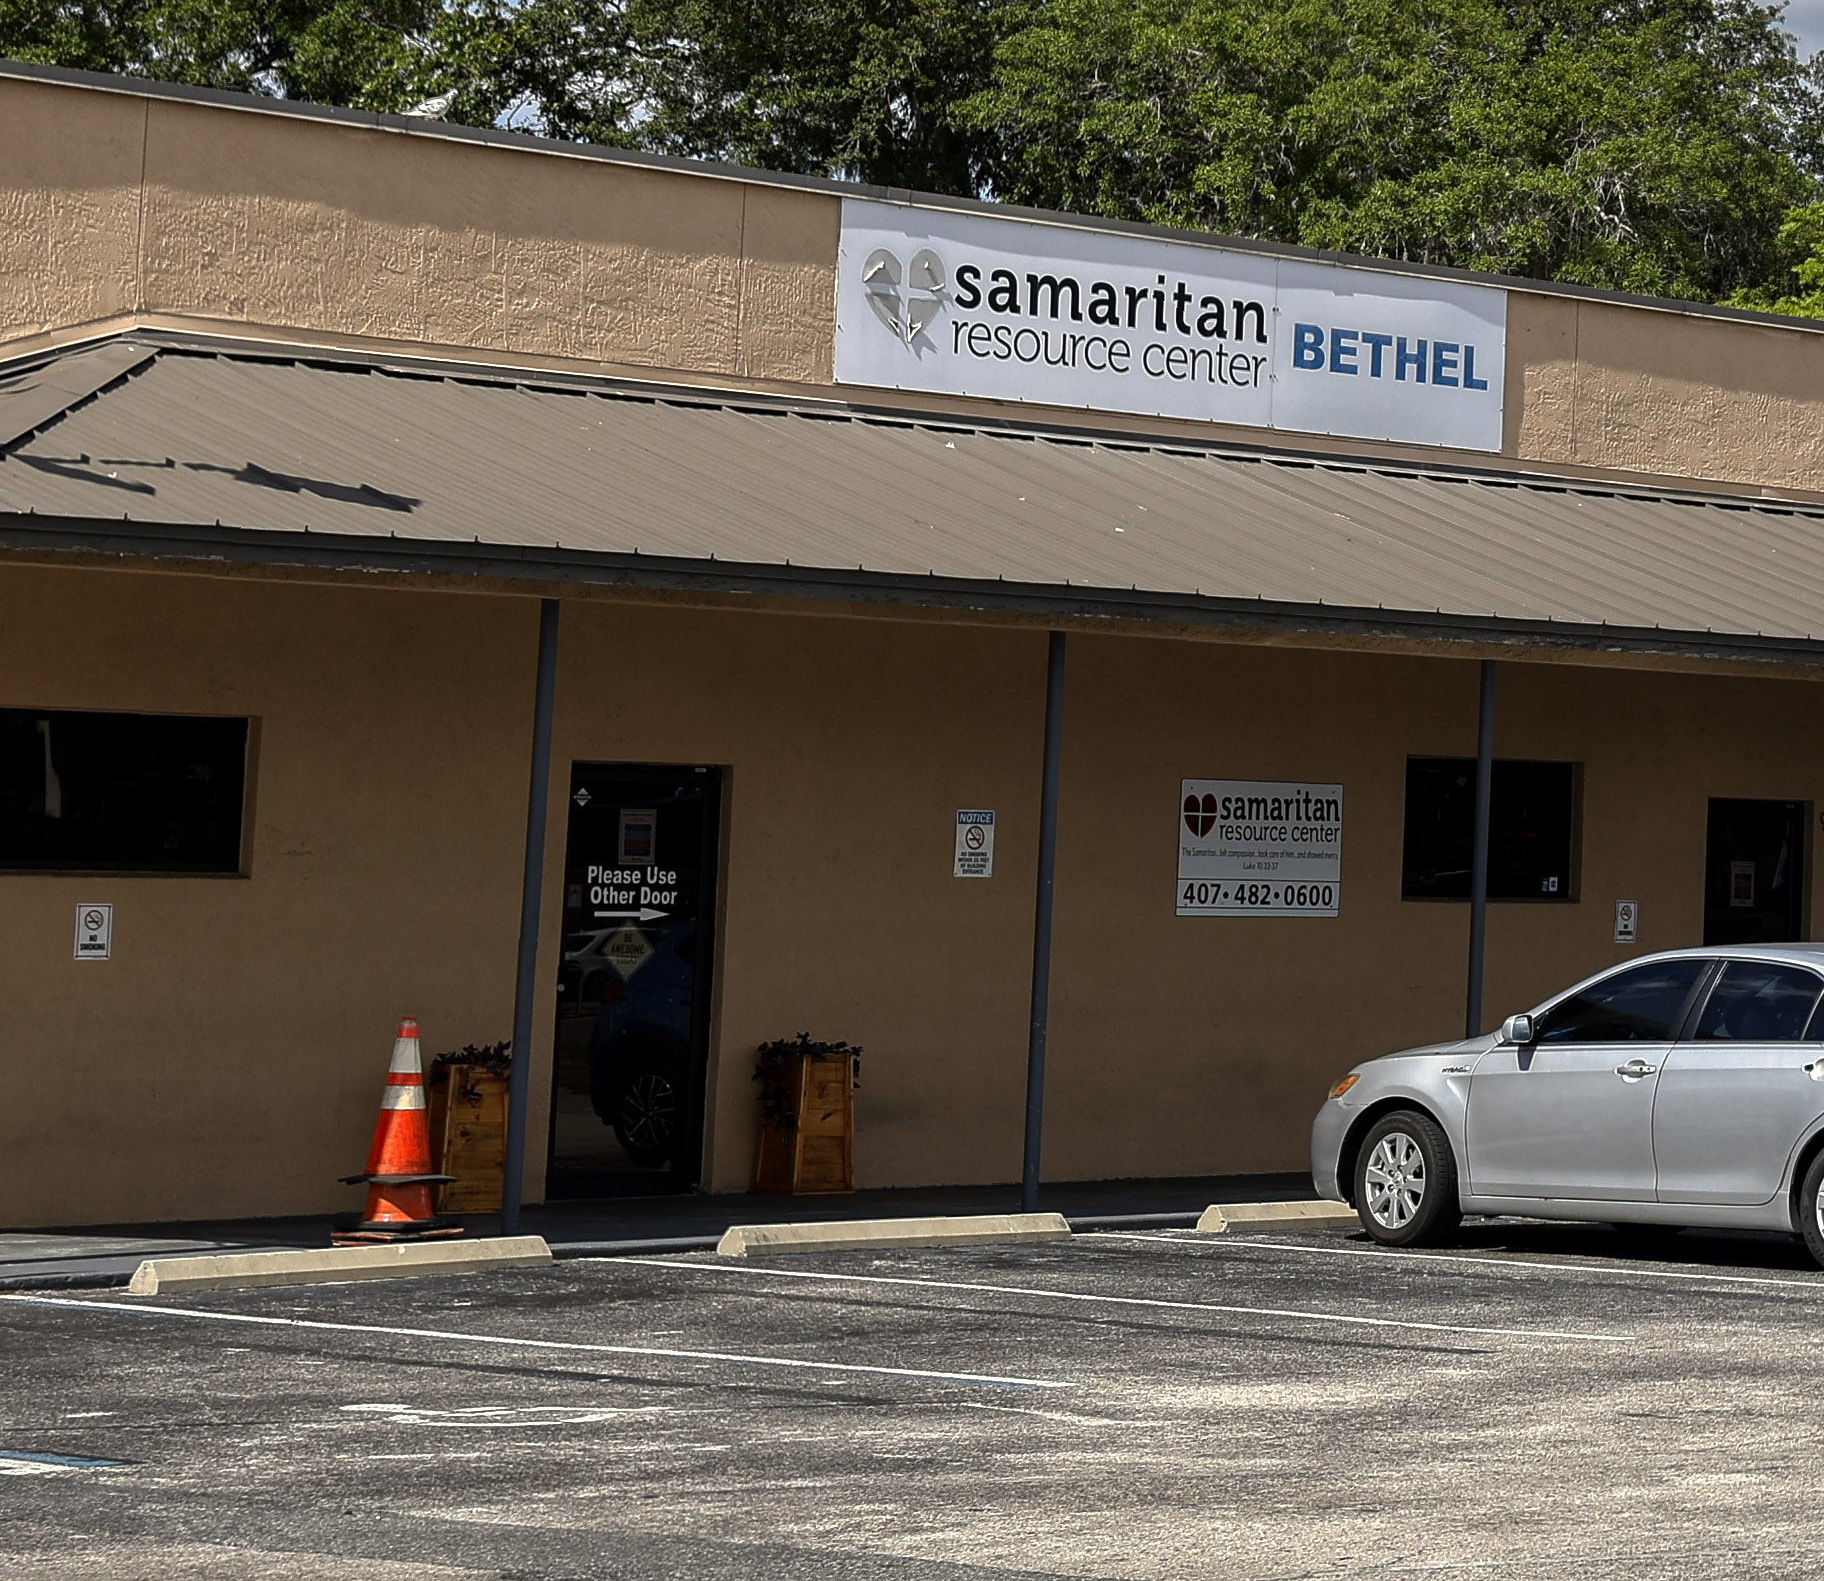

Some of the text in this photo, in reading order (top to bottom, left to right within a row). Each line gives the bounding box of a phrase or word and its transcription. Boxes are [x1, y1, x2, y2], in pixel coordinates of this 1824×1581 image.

[953, 264, 1268, 345] samaritan
[951, 319, 1267, 388] resource center
[1292, 322, 1489, 392] BETHEL
[1219, 788, 1341, 822] samaritan
[960, 813, 992, 823] NOTICE
[1219, 824, 1341, 843] resource center
[587, 865, 677, 885] Please Use
[590, 886, 678, 905] Other Door
[611, 944, 645, 955] AWESOME
